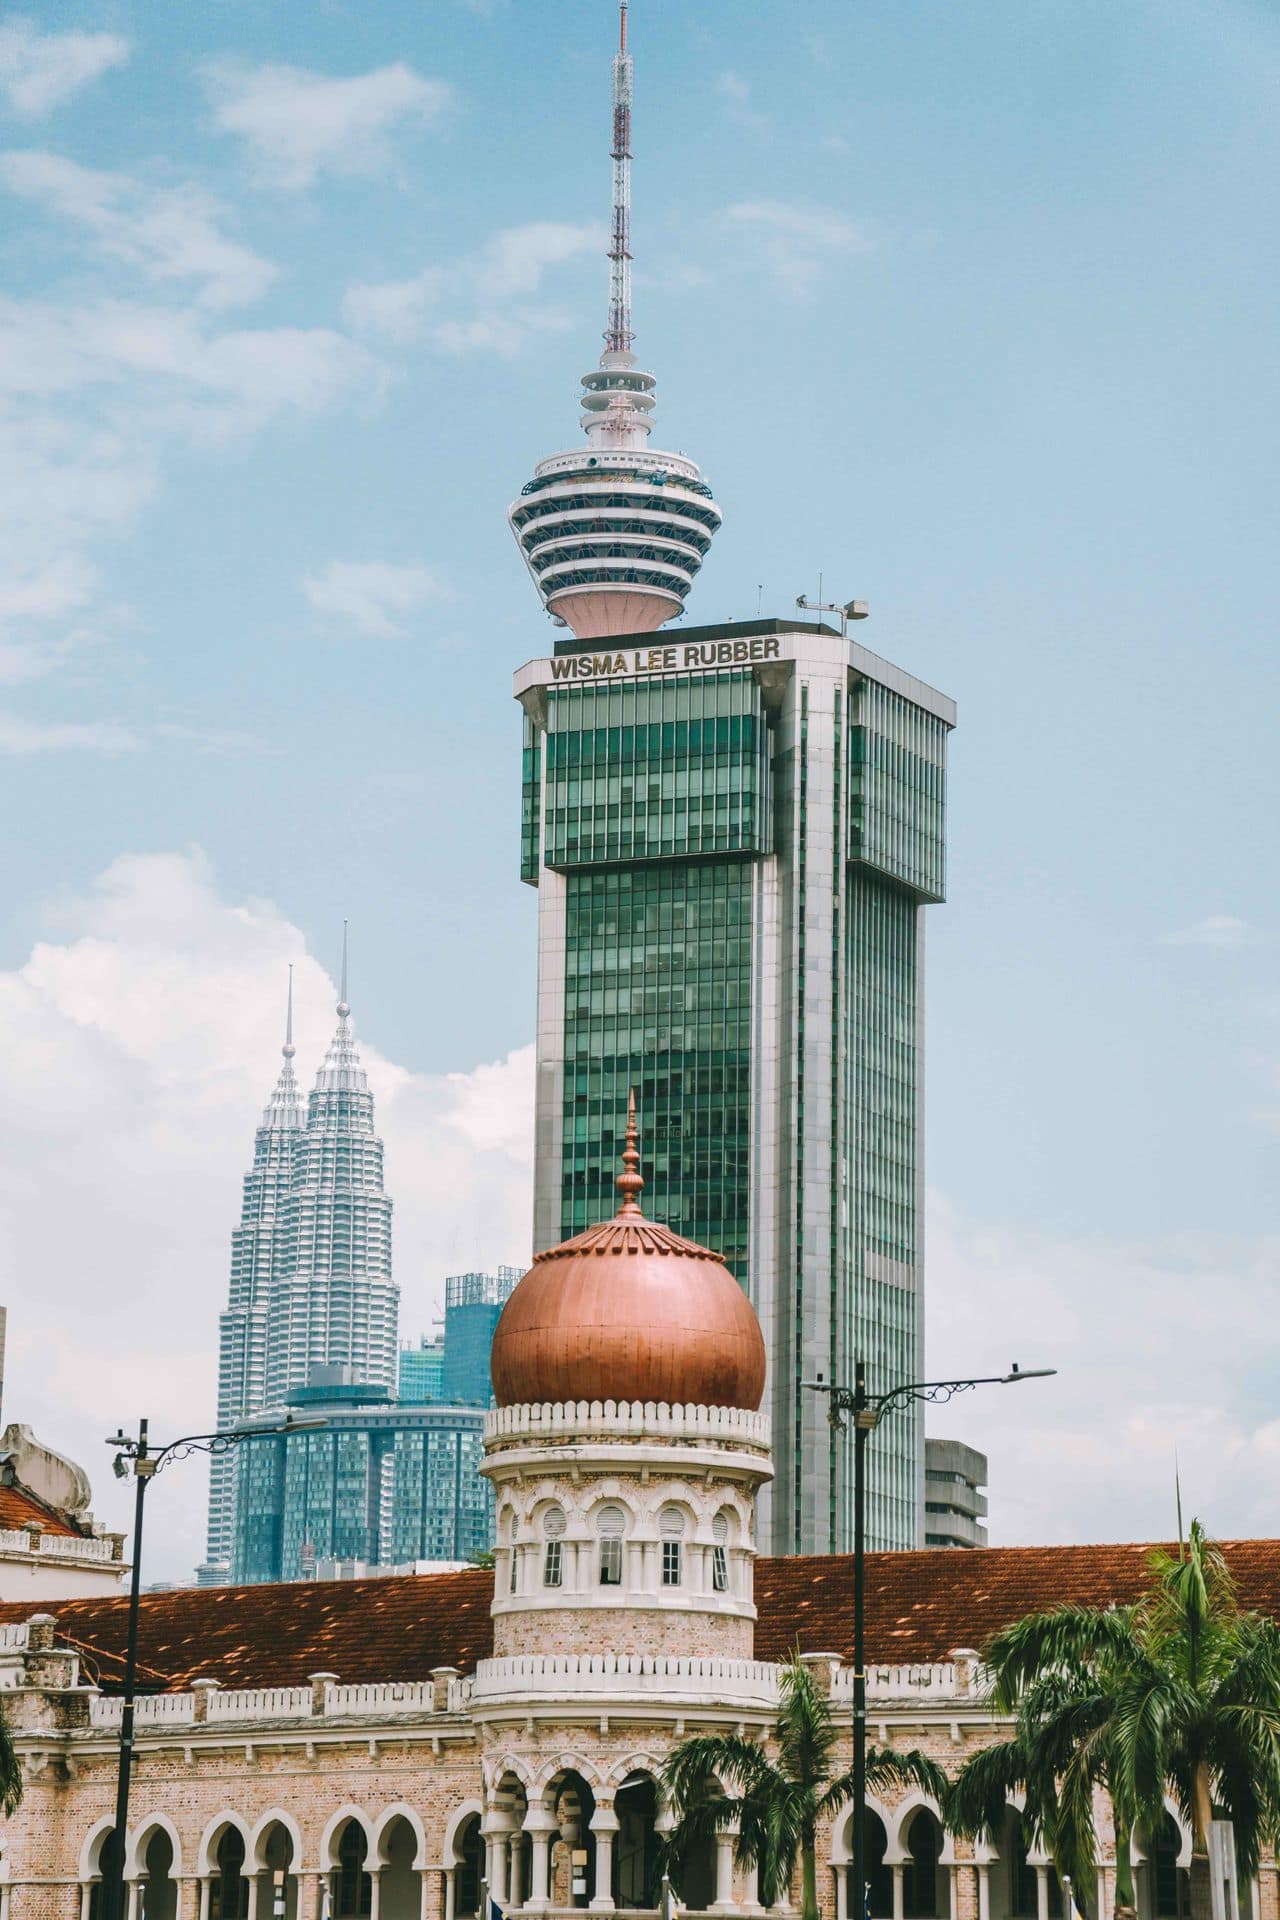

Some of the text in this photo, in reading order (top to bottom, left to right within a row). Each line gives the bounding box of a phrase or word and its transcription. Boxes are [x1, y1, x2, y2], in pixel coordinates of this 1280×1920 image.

[550, 638, 780, 680] WISMA LEE RUBBER
